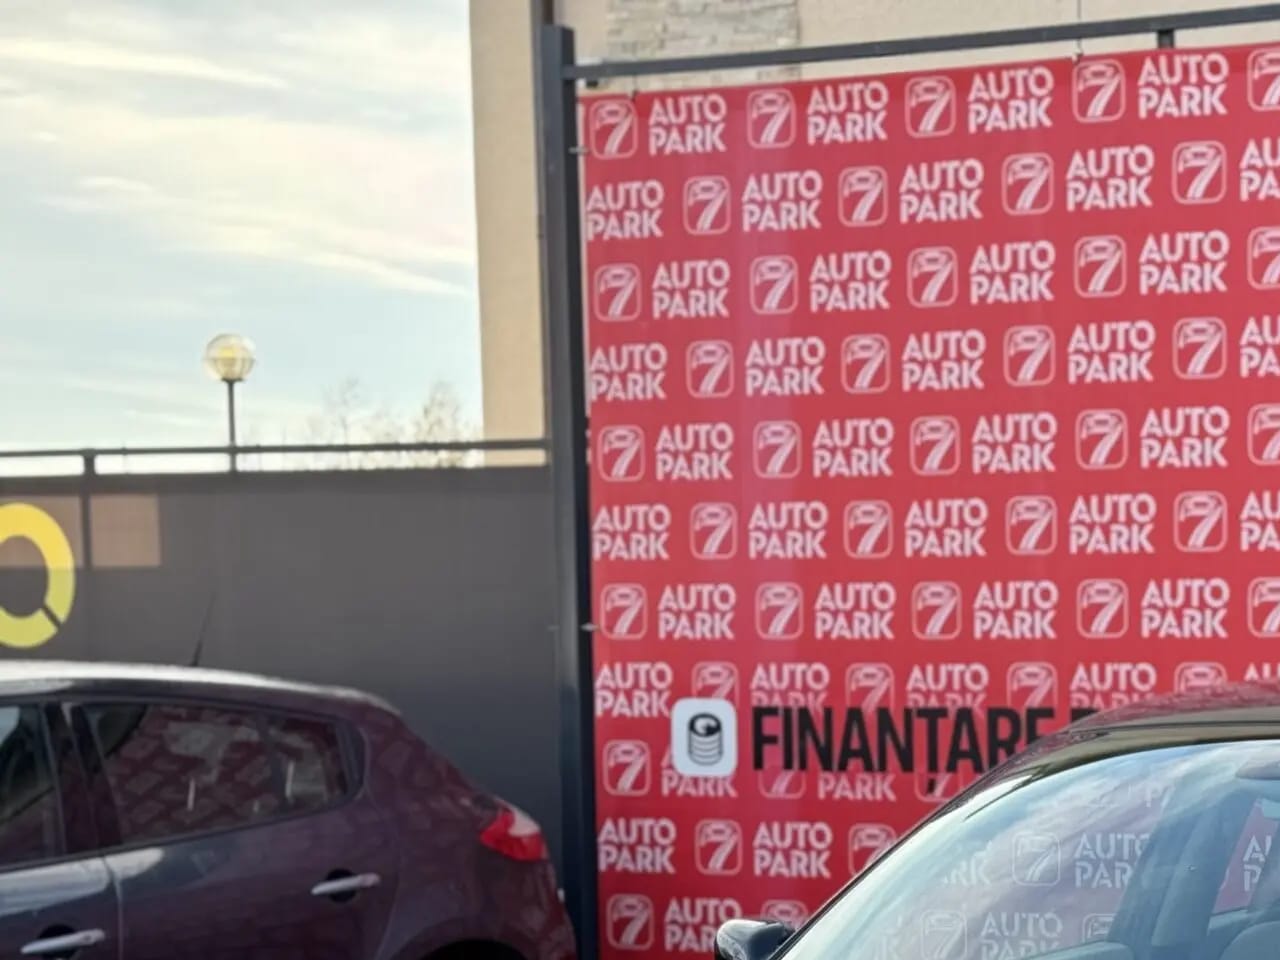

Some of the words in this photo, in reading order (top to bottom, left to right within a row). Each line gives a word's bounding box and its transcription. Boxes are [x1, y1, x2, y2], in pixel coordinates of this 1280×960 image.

[968, 67, 1054, 104] AUTO
[1138, 53, 1229, 92] AUTO
[648, 94, 727, 129] AUTO
[807, 81, 889, 117] AUTO
[1138, 82, 1228, 119] PARK
[807, 110, 888, 145] PARK
[968, 97, 1053, 133] PARK
[648, 122, 727, 155] PARK
[900, 158, 984, 193] AUTO
[1066, 144, 1154, 181] AUTO
[585, 180, 664, 212] AUTO
[742, 170, 822, 203] AUTO
[1067, 175, 1152, 211] PARK
[743, 199, 821, 232] PARK
[900, 188, 982, 223] PARK
[586, 208, 663, 242] PARK
[970, 240, 1055, 275] AUTO
[1139, 230, 1229, 264] AUTO
[652, 259, 730, 290] AUTO
[809, 250, 891, 283] AUTO
[1140, 260, 1227, 295] PARK
[810, 279, 889, 312] PARK
[970, 270, 1053, 304] PARK
[653, 288, 728, 319] PARK
[745, 336, 825, 367] AUTO
[902, 329, 986, 362] AUTO
[1068, 320, 1156, 354] AUTO
[589, 343, 668, 374] AUTO
[1068, 350, 1153, 384] PARK
[591, 371, 666, 402] PARK
[746, 365, 824, 396] PARK
[903, 358, 984, 391] PARK
[656, 423, 733, 452] AUTO
[813, 418, 894, 448] AUTO
[972, 412, 1057, 444] AUTO
[1140, 406, 1230, 438] AUTO
[656, 450, 732, 480] PARK
[813, 446, 892, 477] PARK
[973, 441, 1055, 474] PARK
[1141, 436, 1227, 468] PARK
[593, 503, 672, 533] AUTO
[748, 501, 828, 531] AUTO
[905, 498, 988, 528] AUTO
[1069, 493, 1156, 524] AUTO
[593, 531, 670, 561] PARK
[749, 529, 826, 559] PARK
[905, 526, 986, 557] PARK
[1070, 522, 1154, 554] PARK
[658, 584, 736, 612] AUTO
[815, 582, 896, 612] AUTO
[974, 580, 1058, 610] AUTO
[1141, 578, 1230, 609] AUTO
[659, 610, 734, 639] PARK
[815, 610, 894, 639] PARK
[974, 608, 1056, 639] PARK
[1141, 607, 1227, 638] PARK
[596, 661, 674, 690] AUTO
[751, 662, 830, 691] AUTO
[906, 663, 989, 692] AUTO
[1070, 662, 1156, 691] AUTO
[595, 690, 672, 718] PARK
[817, 774, 896, 801] PARK
[597, 818, 676, 846] AUTO
[753, 822, 833, 850] AUTO
[598, 843, 675, 874] PARK
[754, 849, 830, 878] PARK
[665, 898, 743, 925] AUTO
[980, 912, 1062, 938] AUTO
